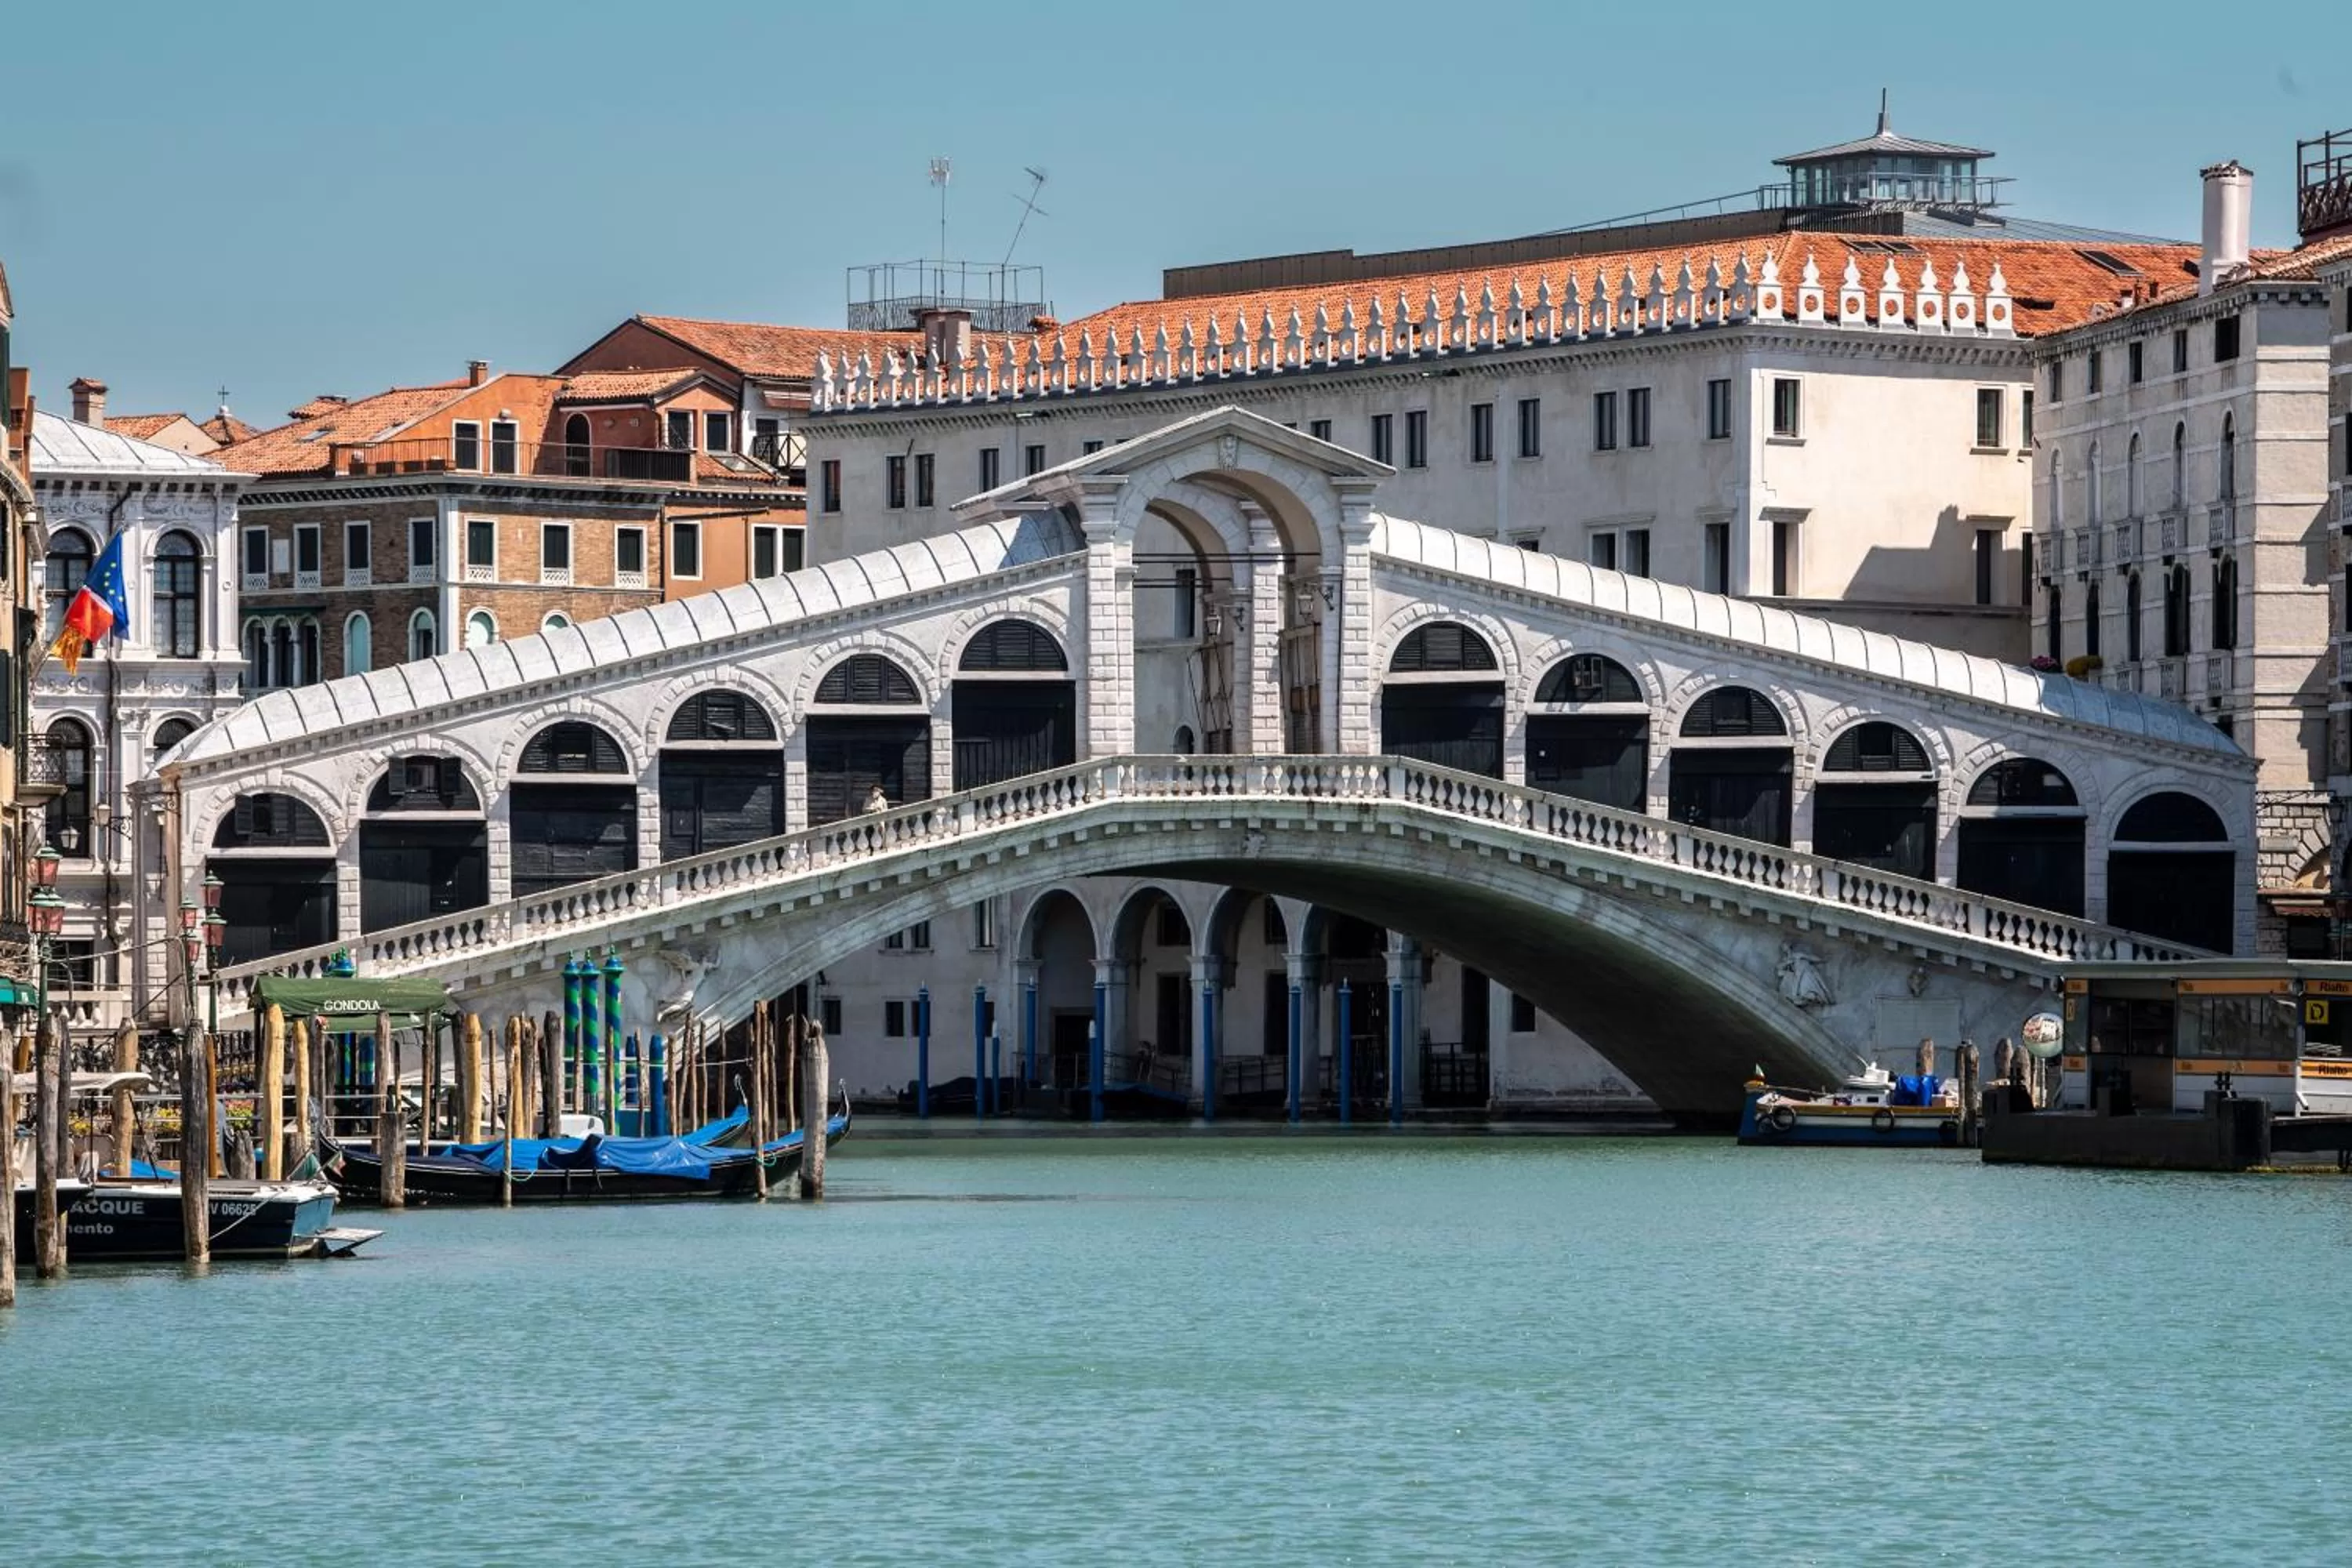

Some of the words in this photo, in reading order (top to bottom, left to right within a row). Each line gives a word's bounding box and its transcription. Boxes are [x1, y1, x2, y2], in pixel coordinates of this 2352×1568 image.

[2320, 981, 2349, 992] Rialto
[324, 1000, 381, 1011] GONDOLA
[2310, 1003, 2325, 1020] D
[2318, 1064, 2348, 1075] Rialto
[70, 1200, 145, 1215] ACQUE
